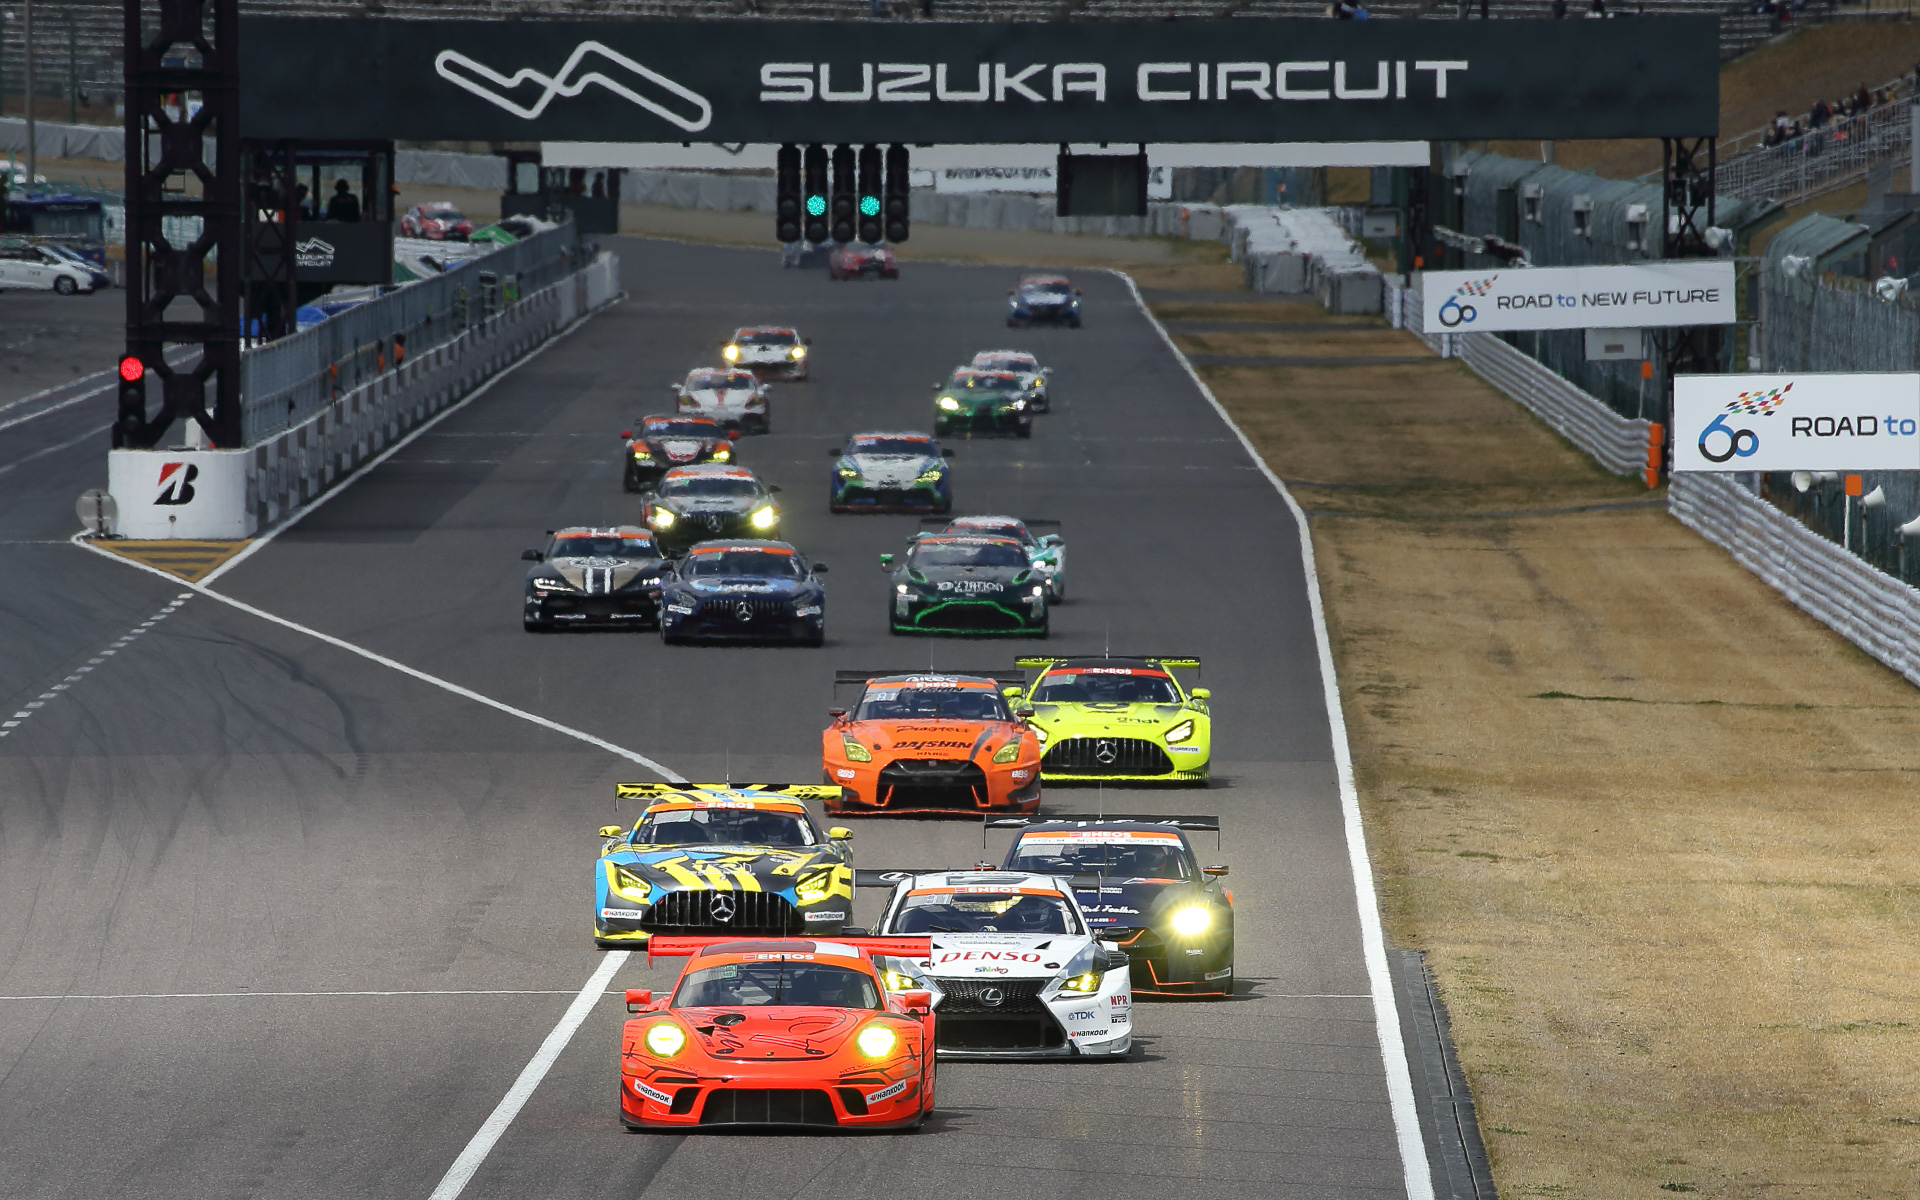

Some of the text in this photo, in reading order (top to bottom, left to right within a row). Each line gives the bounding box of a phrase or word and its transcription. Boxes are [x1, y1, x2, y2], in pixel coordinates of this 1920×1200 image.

[760, 60, 1469, 102] SUZUKA CIRCUIT
[1497, 295, 1553, 309] ROAD
[1557, 294, 1577, 308] to
[1582, 292, 1628, 308] NEW
[1633, 288, 1720, 306] FUTURE
[1791, 416, 1877, 437] ROAD
[1884, 415, 1916, 436] to
[707, 801, 755, 810] ENEOS
[1082, 831, 1132, 839] ENEOS
[967, 886, 1021, 894] ENEOS
[757, 953, 815, 961] ENEOS
[940, 951, 1042, 963] DENSO
[1110, 994, 1128, 1006] NPR
[1074, 1011, 1095, 1020] TDK
